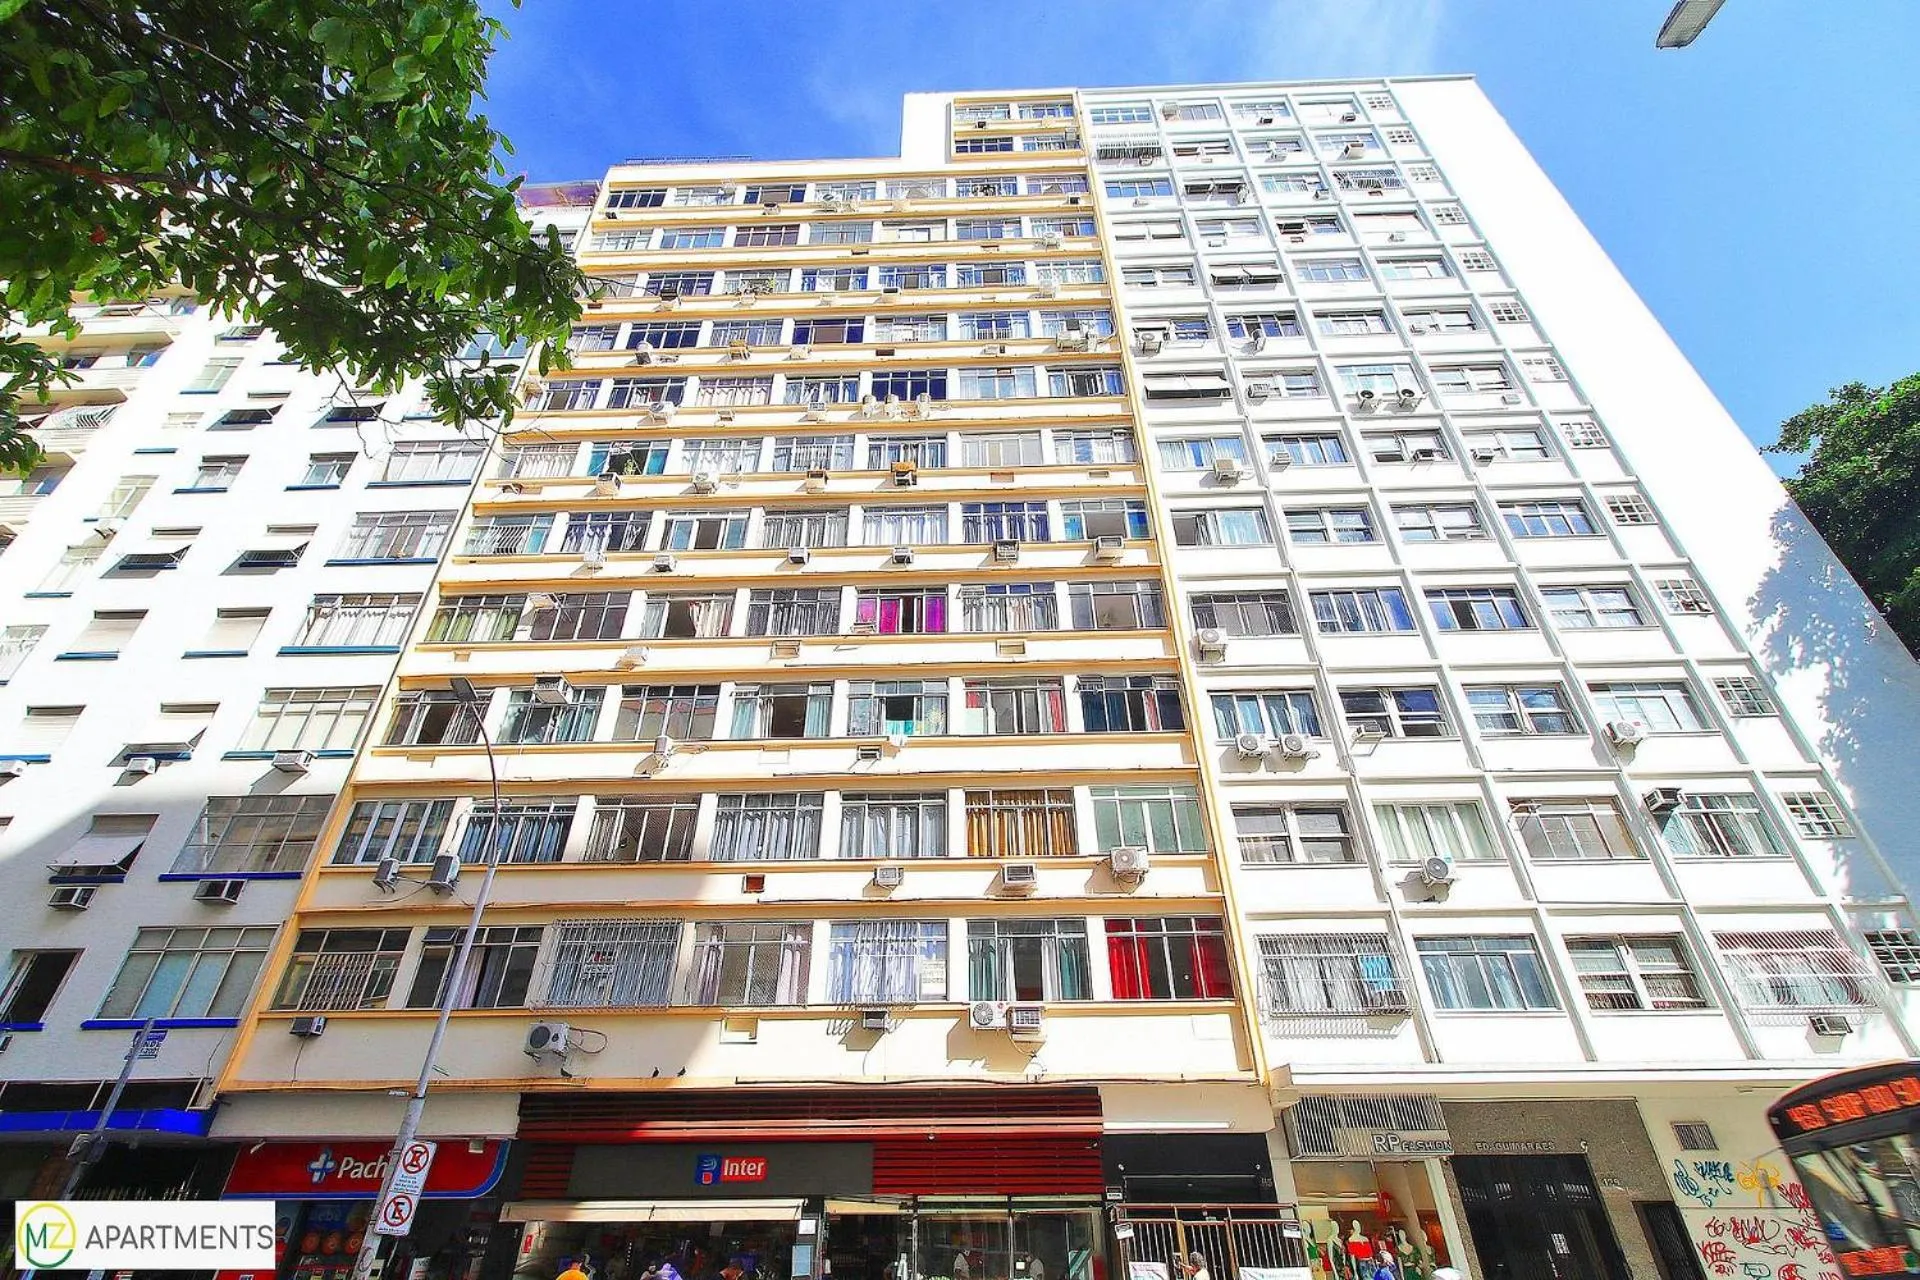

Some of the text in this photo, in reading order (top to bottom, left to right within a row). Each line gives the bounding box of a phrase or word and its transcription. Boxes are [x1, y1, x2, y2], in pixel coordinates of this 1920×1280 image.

[1372, 1133, 1453, 1152] RP FASHION
[337, 1154, 389, 1179] Pach
[723, 1159, 765, 1176] Inter
